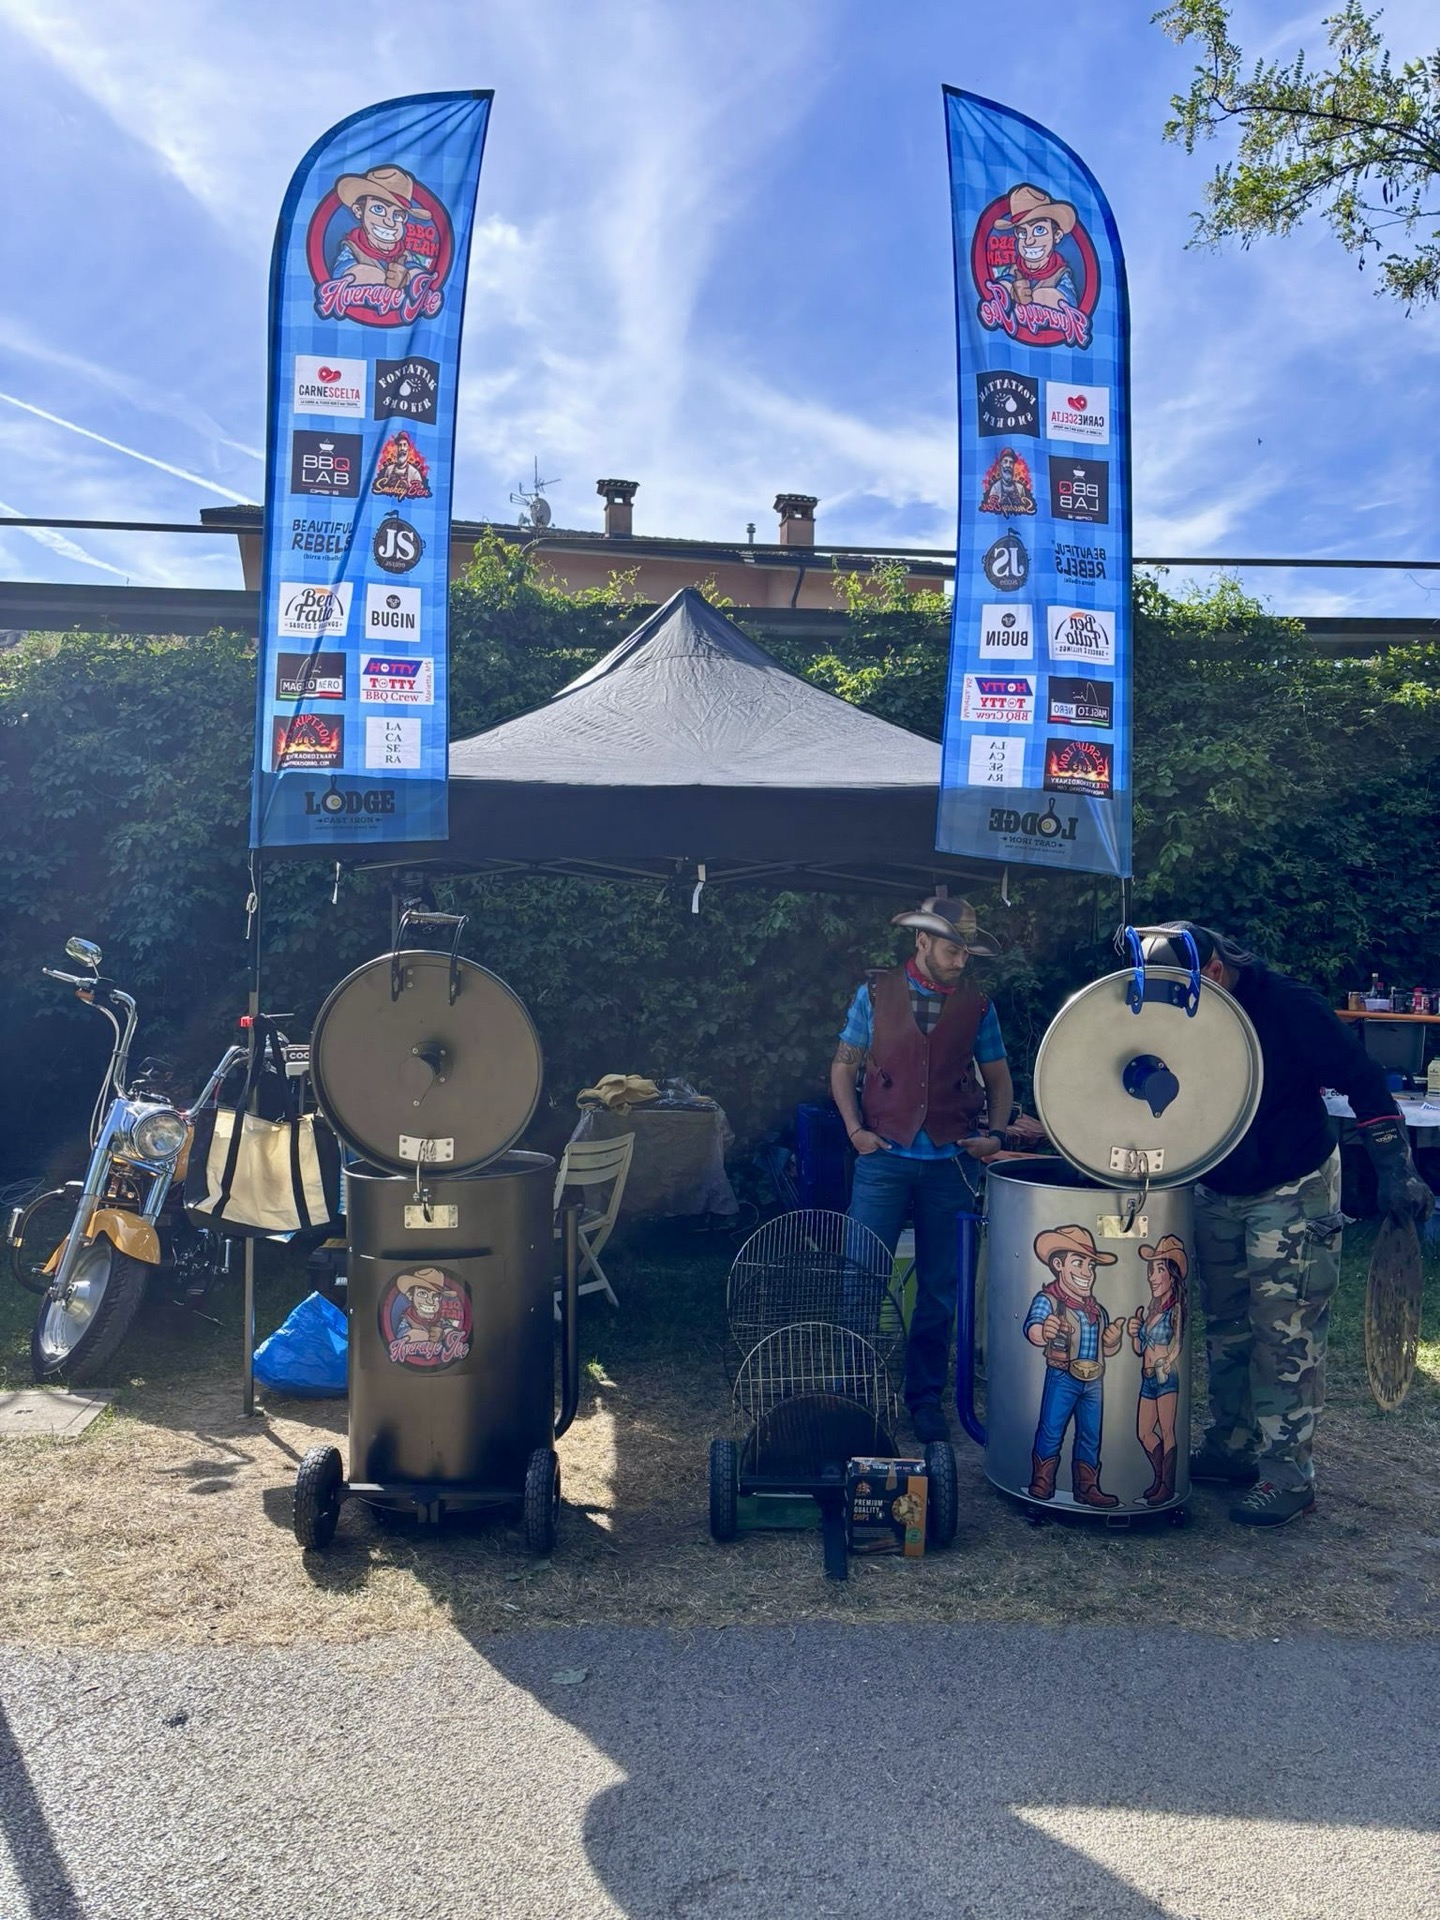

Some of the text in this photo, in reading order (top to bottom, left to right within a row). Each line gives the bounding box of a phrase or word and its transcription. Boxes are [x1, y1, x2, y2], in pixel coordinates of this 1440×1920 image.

[407, 223, 435, 240] BBQ
[405, 238, 439, 256] TEAM
[321, 271, 442, 322] Average Joe
[299, 384, 361, 400] CARNESCELTA
[383, 396, 431, 413] SMOKER
[302, 454, 350, 471] BBQ
[302, 470, 350, 485] LAB
[407, 480, 430, 496] Ben
[292, 519, 353, 534] BEAUTIFUL
[291, 532, 353, 554] REBELS
[378, 528, 415, 560] JS
[301, 588, 333, 607] Ben
[371, 610, 415, 629] BUGIN
[369, 662, 416, 674] HOTTY
[318, 680, 340, 690] NERO
[369, 677, 416, 690] TOTTY
[365, 691, 419, 703] BBQ Crew
[386, 721, 402, 731] LA
[385, 732, 402, 742] CA
[386, 744, 401, 752] SE
[385, 755, 402, 764] RA
[304, 787, 395, 815] LODGE
[389, 1330, 469, 1362] Average Joe
[854, 1499, 883, 1507] PREMIUM
[854, 1506, 880, 1514] QUALITY
